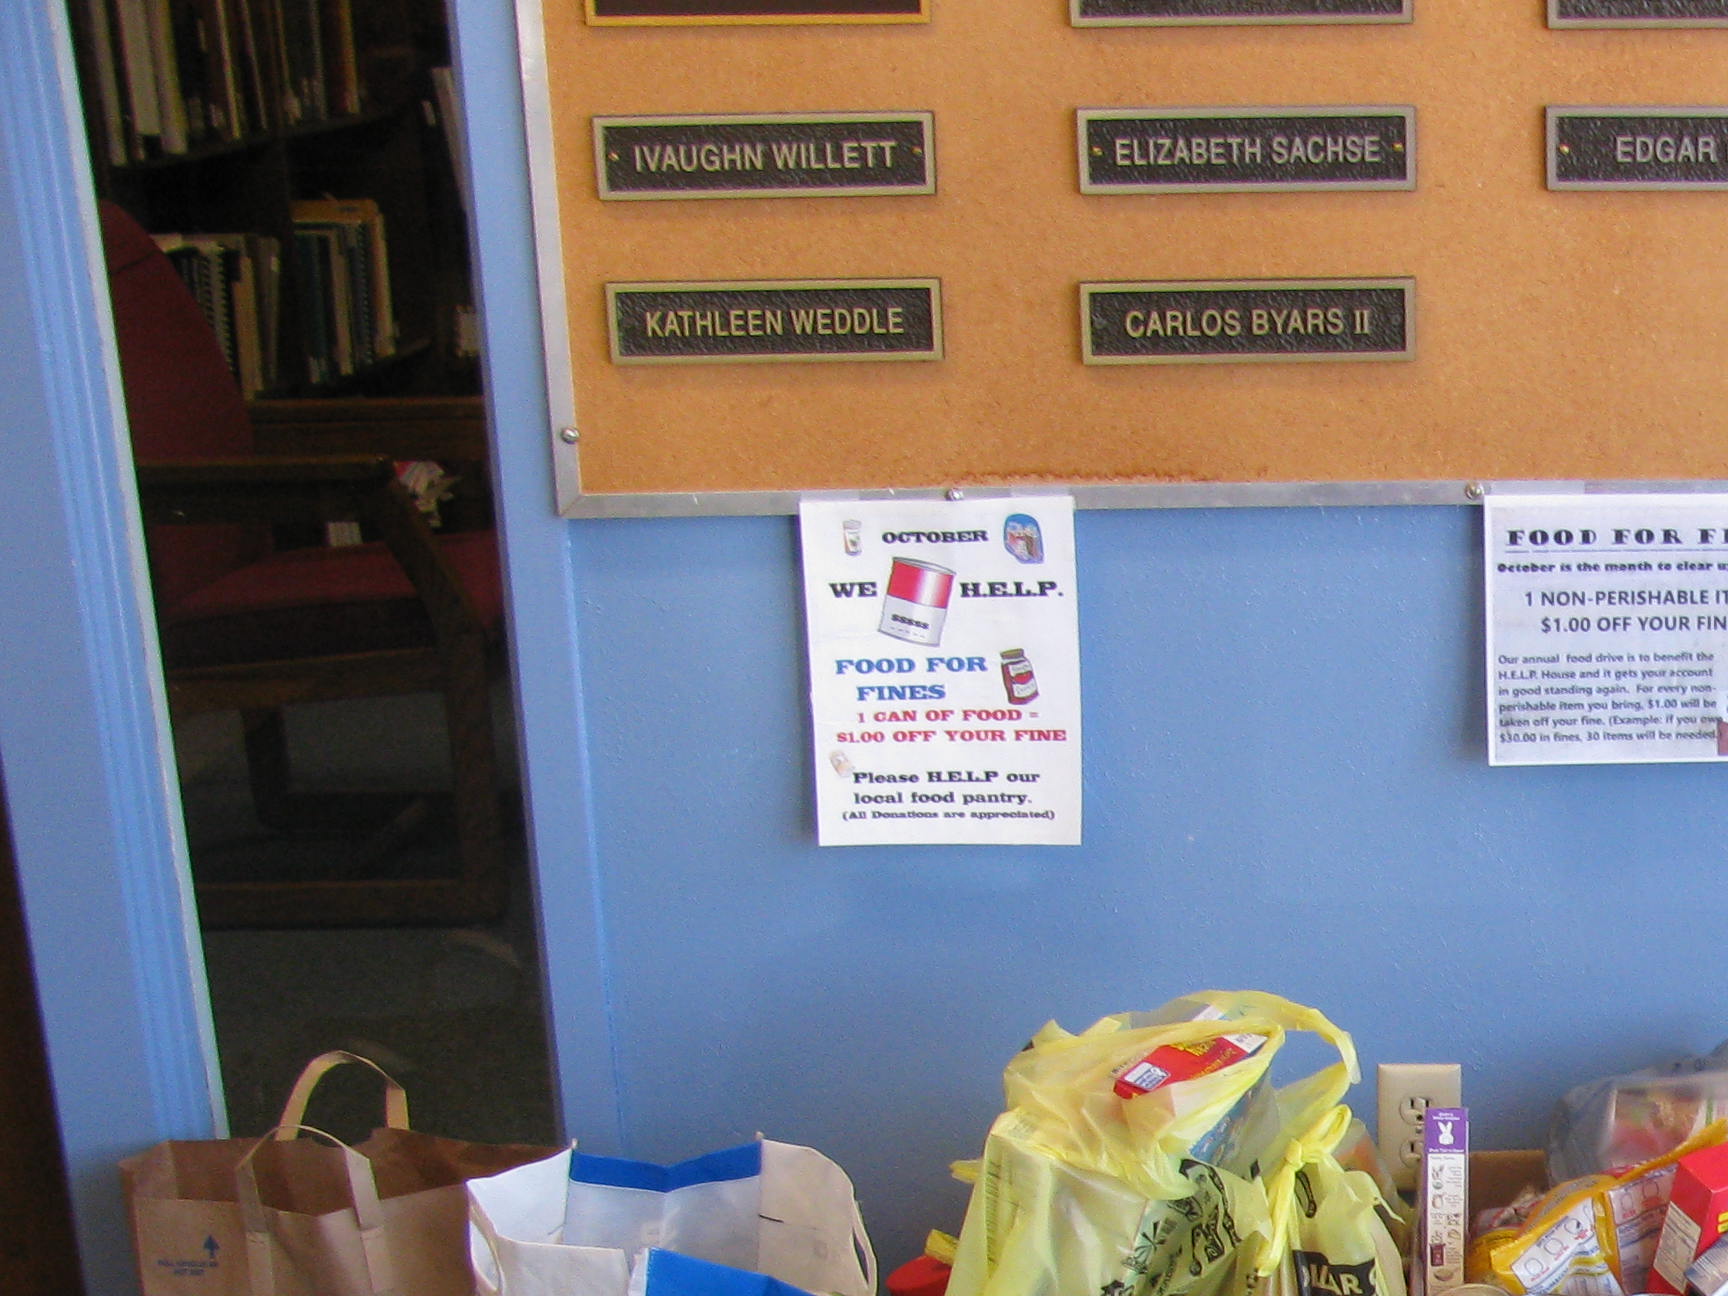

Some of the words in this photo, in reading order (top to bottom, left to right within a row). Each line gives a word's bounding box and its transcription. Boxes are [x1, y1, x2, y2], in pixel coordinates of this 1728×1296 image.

[634, 145, 762, 174] IVAUGHN
[770, 141, 896, 169] WILLETT
[1115, 137, 1261, 165] ELIZABETH
[1273, 137, 1380, 164] SACHSE
[1615, 137, 1717, 164] EDGAR
[645, 311, 784, 338] KATHLEEN
[792, 307, 903, 335] WEDDLE
[1125, 311, 1241, 338] CARLOS
[1251, 309, 1343, 336] BYARS
[1354, 310, 1370, 335] II
[882, 530, 989, 544] OCTOBER
[1505, 529, 1597, 546] FOOD
[1611, 528, 1682, 545] FOR
[1497, 561, 1556, 573] October
[1560, 562, 1572, 572] is
[1577, 561, 1600, 572] the
[1605, 561, 1653, 572] month
[1658, 561, 1672, 571] to
[1676, 561, 1713, 571] clear
[829, 581, 877, 599] WE
[960, 581, 1063, 598] H.E.L.P.
[1525, 592, 1532, 607] 1
[1541, 590, 1709, 606] NON-PERISHABLE
[1541, 616, 1591, 634] $1.00
[1596, 617, 1632, 632] OFF
[1637, 616, 1690, 631] YOUR
[835, 658, 916, 674] FOOD
[926, 657, 988, 673] FOR
[1498, 655, 1519, 664] Our
[1522, 654, 1560, 664] annual
[1566, 653, 1592, 663] food
[1595, 653, 1623, 662] drive
[1639, 653, 1650, 661] to
[1653, 652, 1693, 661] benefit
[1696, 652, 1714, 661] the
[1541, 670, 1576, 679] House
[1579, 669, 1600, 679] and
[1614, 669, 1638, 680] gets
[1641, 670, 1666, 680] your
[1670, 668, 1713, 678] account
[856, 685, 946, 701] FINES
[1512, 685, 1541, 698] good
[1544, 684, 1593, 696] standing
[1636, 685, 1654, 694] For
[1657, 685, 1688, 695] every
[1499, 701, 1557, 714] perishable
[1559, 701, 1584, 710] item
[1587, 702, 1608, 712] you
[1648, 699, 1677, 709] $1.00
[1680, 699, 1700, 708] will
[1703, 699, 1717, 708] be
[873, 710, 917, 722] CAN
[925, 710, 954, 722] OF
[962, 709, 1022, 721] FOOD
[1499, 717, 1530, 727] taken
[1532, 717, 1549, 726] off
[1552, 718, 1578, 728] your
[1676, 716, 1697, 726] you
[893, 730, 936, 742] OFF
[944, 730, 1006, 742] YOUR
[1014, 729, 1067, 742] FINE
[1586, 732, 1600, 741] 30
[1603, 731, 1633, 740] items
[1636, 731, 1656, 740] will
[1659, 731, 1672, 740] be
[853, 772, 919, 784] Please
[1006, 773, 1041, 783] our
[853, 792, 903, 804] local
[911, 791, 955, 804] food
[962, 793, 1032, 806] pantry.
[871, 810, 938, 819] Donations
[943, 811, 966, 819] are
[970, 810, 1055, 821] appreciated)
